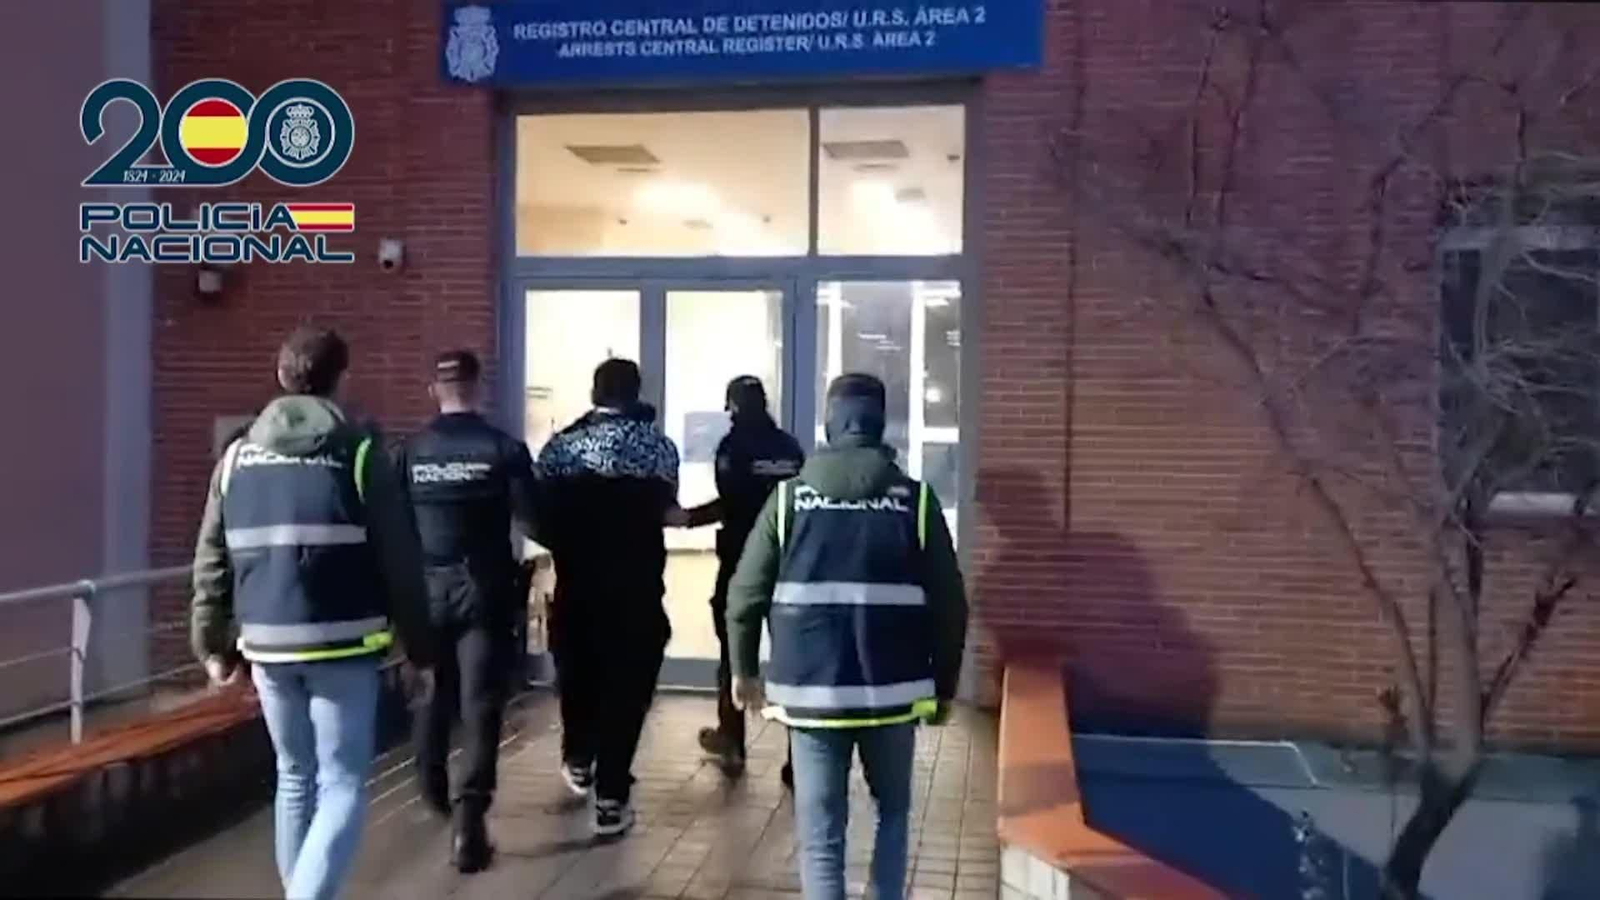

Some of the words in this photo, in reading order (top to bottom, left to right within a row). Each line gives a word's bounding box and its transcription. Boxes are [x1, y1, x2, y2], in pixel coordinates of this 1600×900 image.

[513, 20, 606, 39] REGISTRO
[610, 17, 698, 36] CENTRAL
[703, 15, 728, 33] DE
[733, 12, 848, 32] DETENIDOS/
[974, 6, 986, 23] 2
[558, 41, 637, 57] ARRESTS
[640, 39, 718, 55] CENTRAL
[722, 34, 813, 53] REGISTER/
[925, 31, 936, 46] 2
